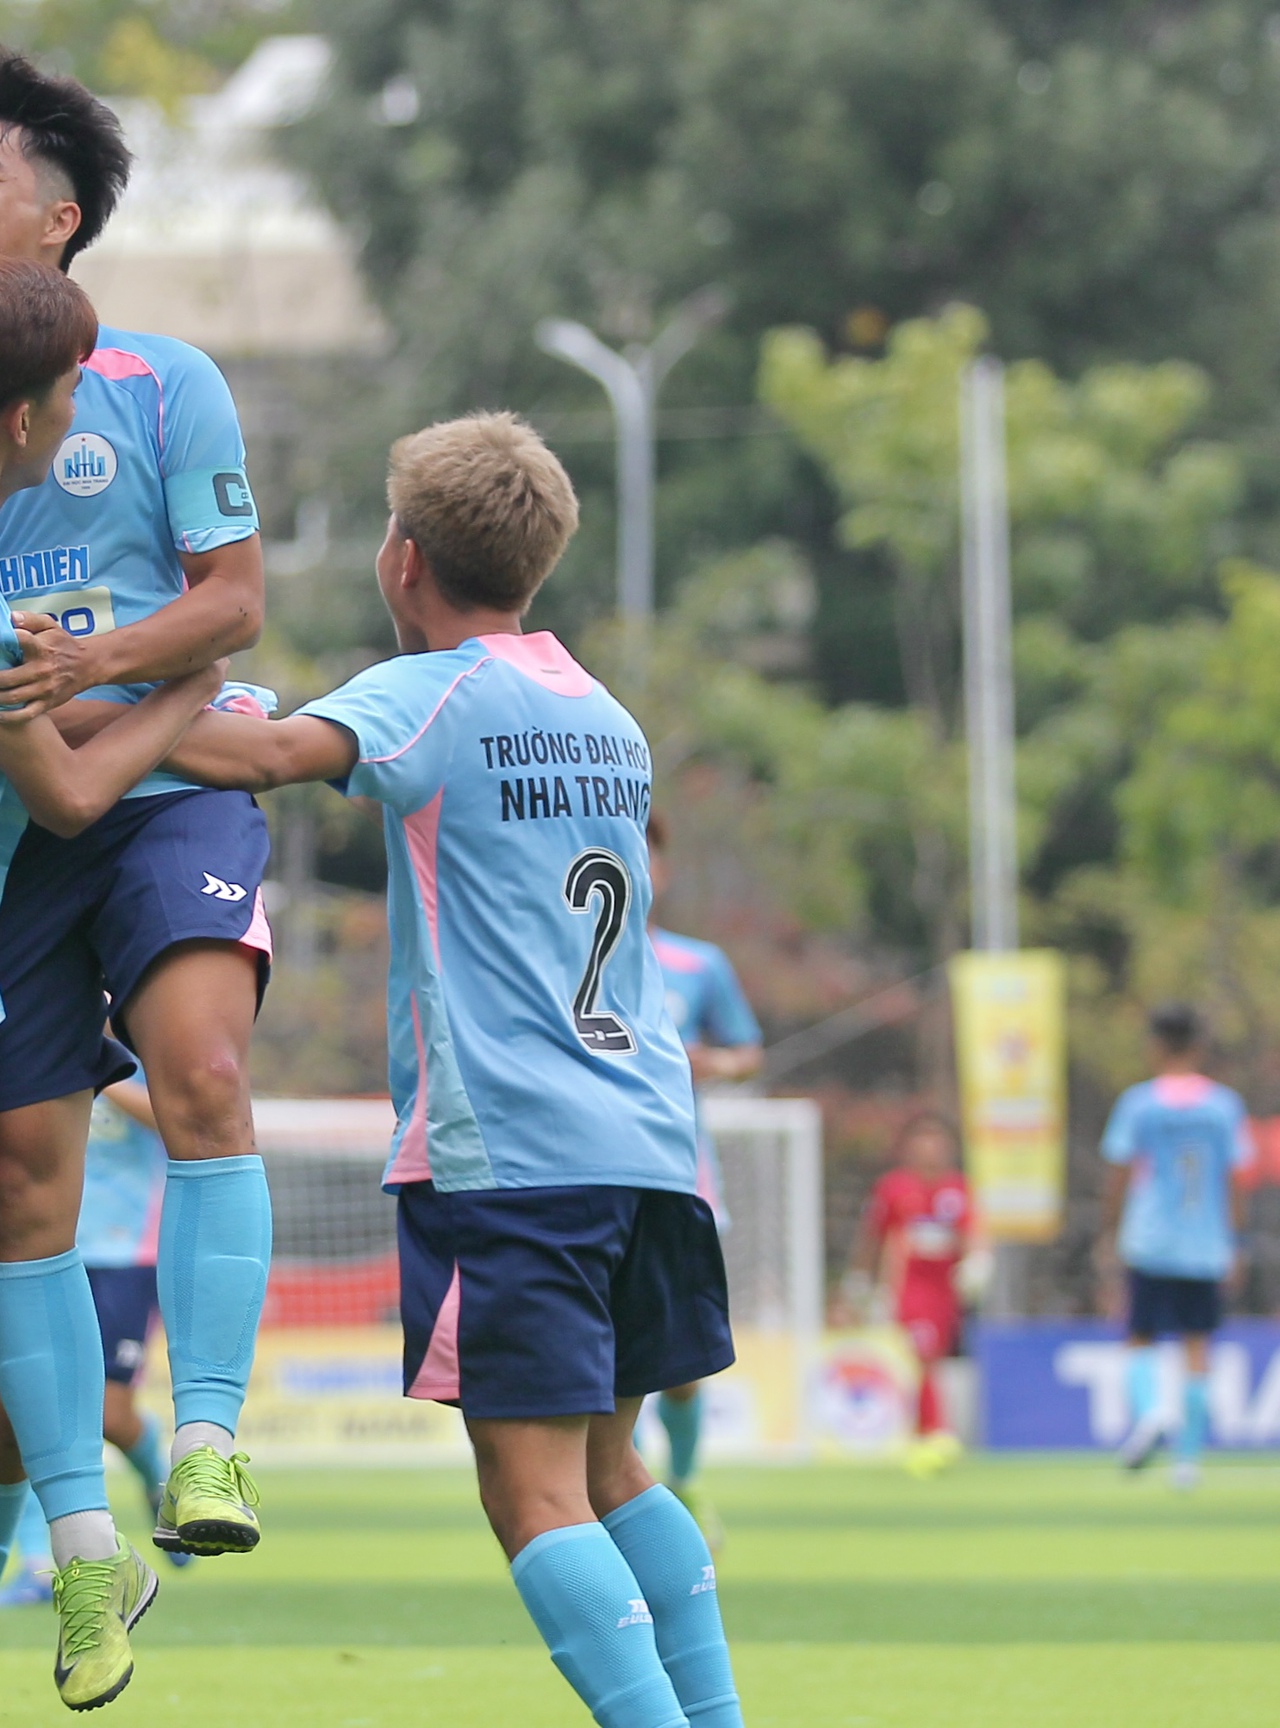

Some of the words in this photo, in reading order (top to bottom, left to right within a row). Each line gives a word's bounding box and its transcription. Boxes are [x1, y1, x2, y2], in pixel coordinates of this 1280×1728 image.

[67, 462, 102, 479] NTU
[212, 472, 253, 517] C
[480, 726, 582, 769] TRƯỜNG
[584, 734, 622, 772] ĐẠI
[500, 776, 573, 821] NHA
[575, 776, 651, 821] TRANG
[562, 846, 638, 1055] 2
